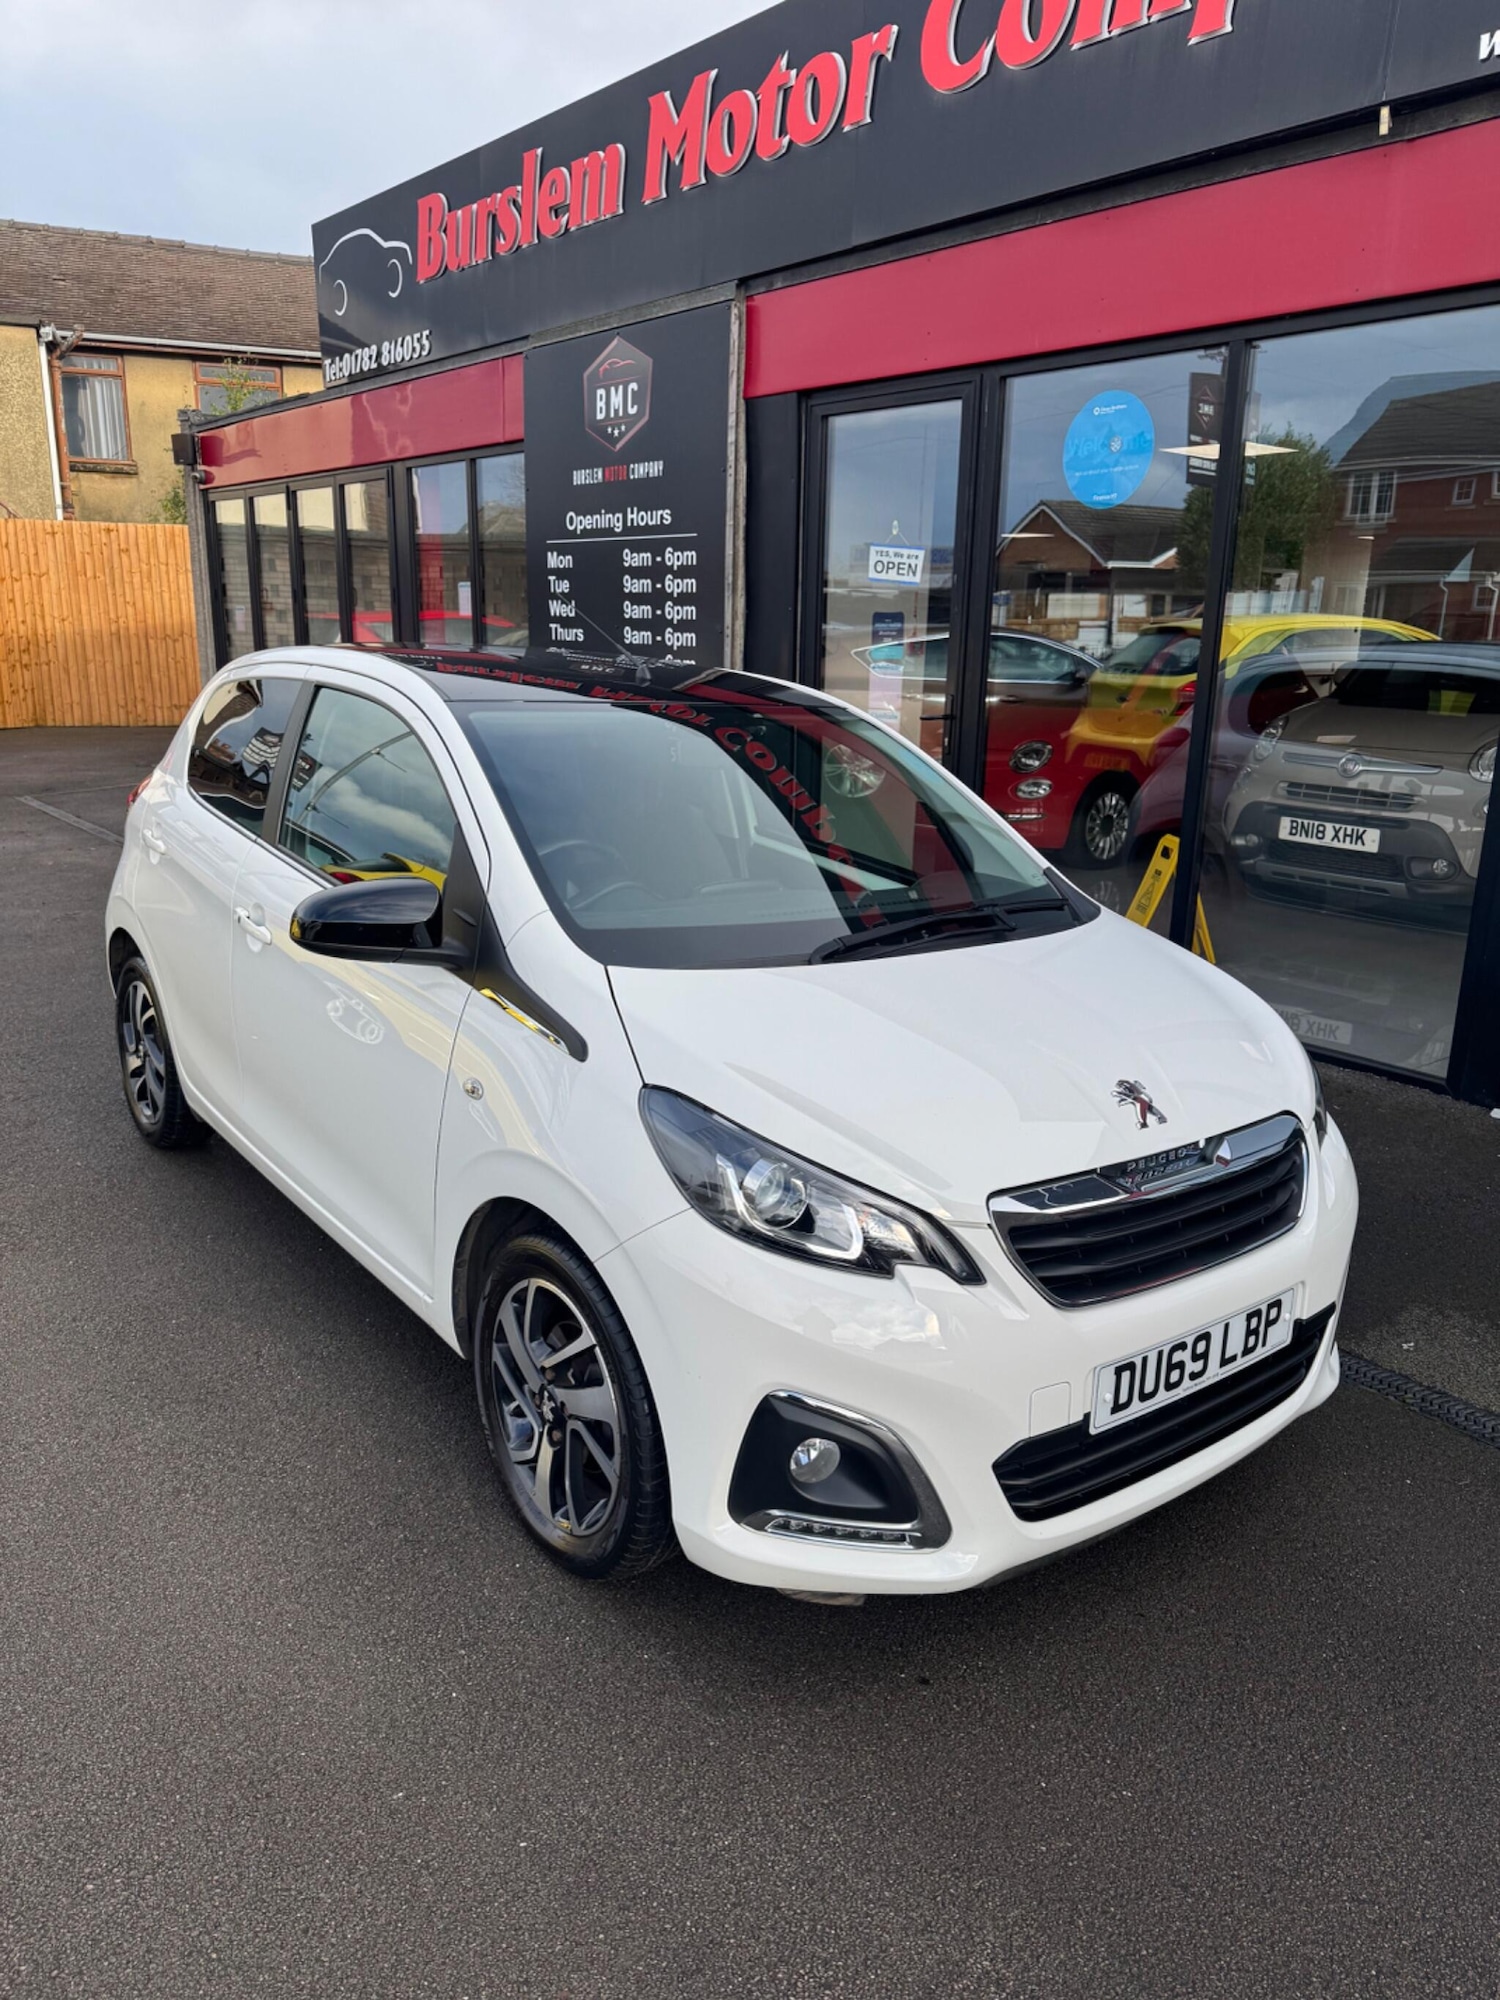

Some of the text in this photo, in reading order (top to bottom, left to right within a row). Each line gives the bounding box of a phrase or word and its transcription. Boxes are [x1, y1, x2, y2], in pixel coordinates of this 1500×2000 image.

[416, 143, 626, 284] Burslem
[641, 24, 899, 205] Motor
[323, 329, 432, 382] Tel:01782 816055
[596, 382, 639, 420] BMC
[1068, 434, 1151, 458] Welcme
[573, 460, 664, 486] BURSLEM MOTOR COMPANY
[566, 507, 672, 534] Opening Hours
[547, 551, 573, 568] Mon
[623, 548, 652, 567] 9am
[664, 547, 697, 571] 6pm
[873, 560, 919, 577] OPEN
[548, 576, 570, 593] Tue
[623, 575, 652, 593] 9am
[664, 574, 697, 598] 6pm
[548, 600, 576, 617] Wed
[623, 601, 652, 619] 9am
[664, 601, 697, 625] 6pm
[549, 623, 584, 642] Thurs
[623, 626, 652, 645] 9am
[664, 627, 697, 651] 6pm
[1288, 819, 1368, 847] BN18 XHK
[1110, 1298, 1283, 1416] DU69 LBP
